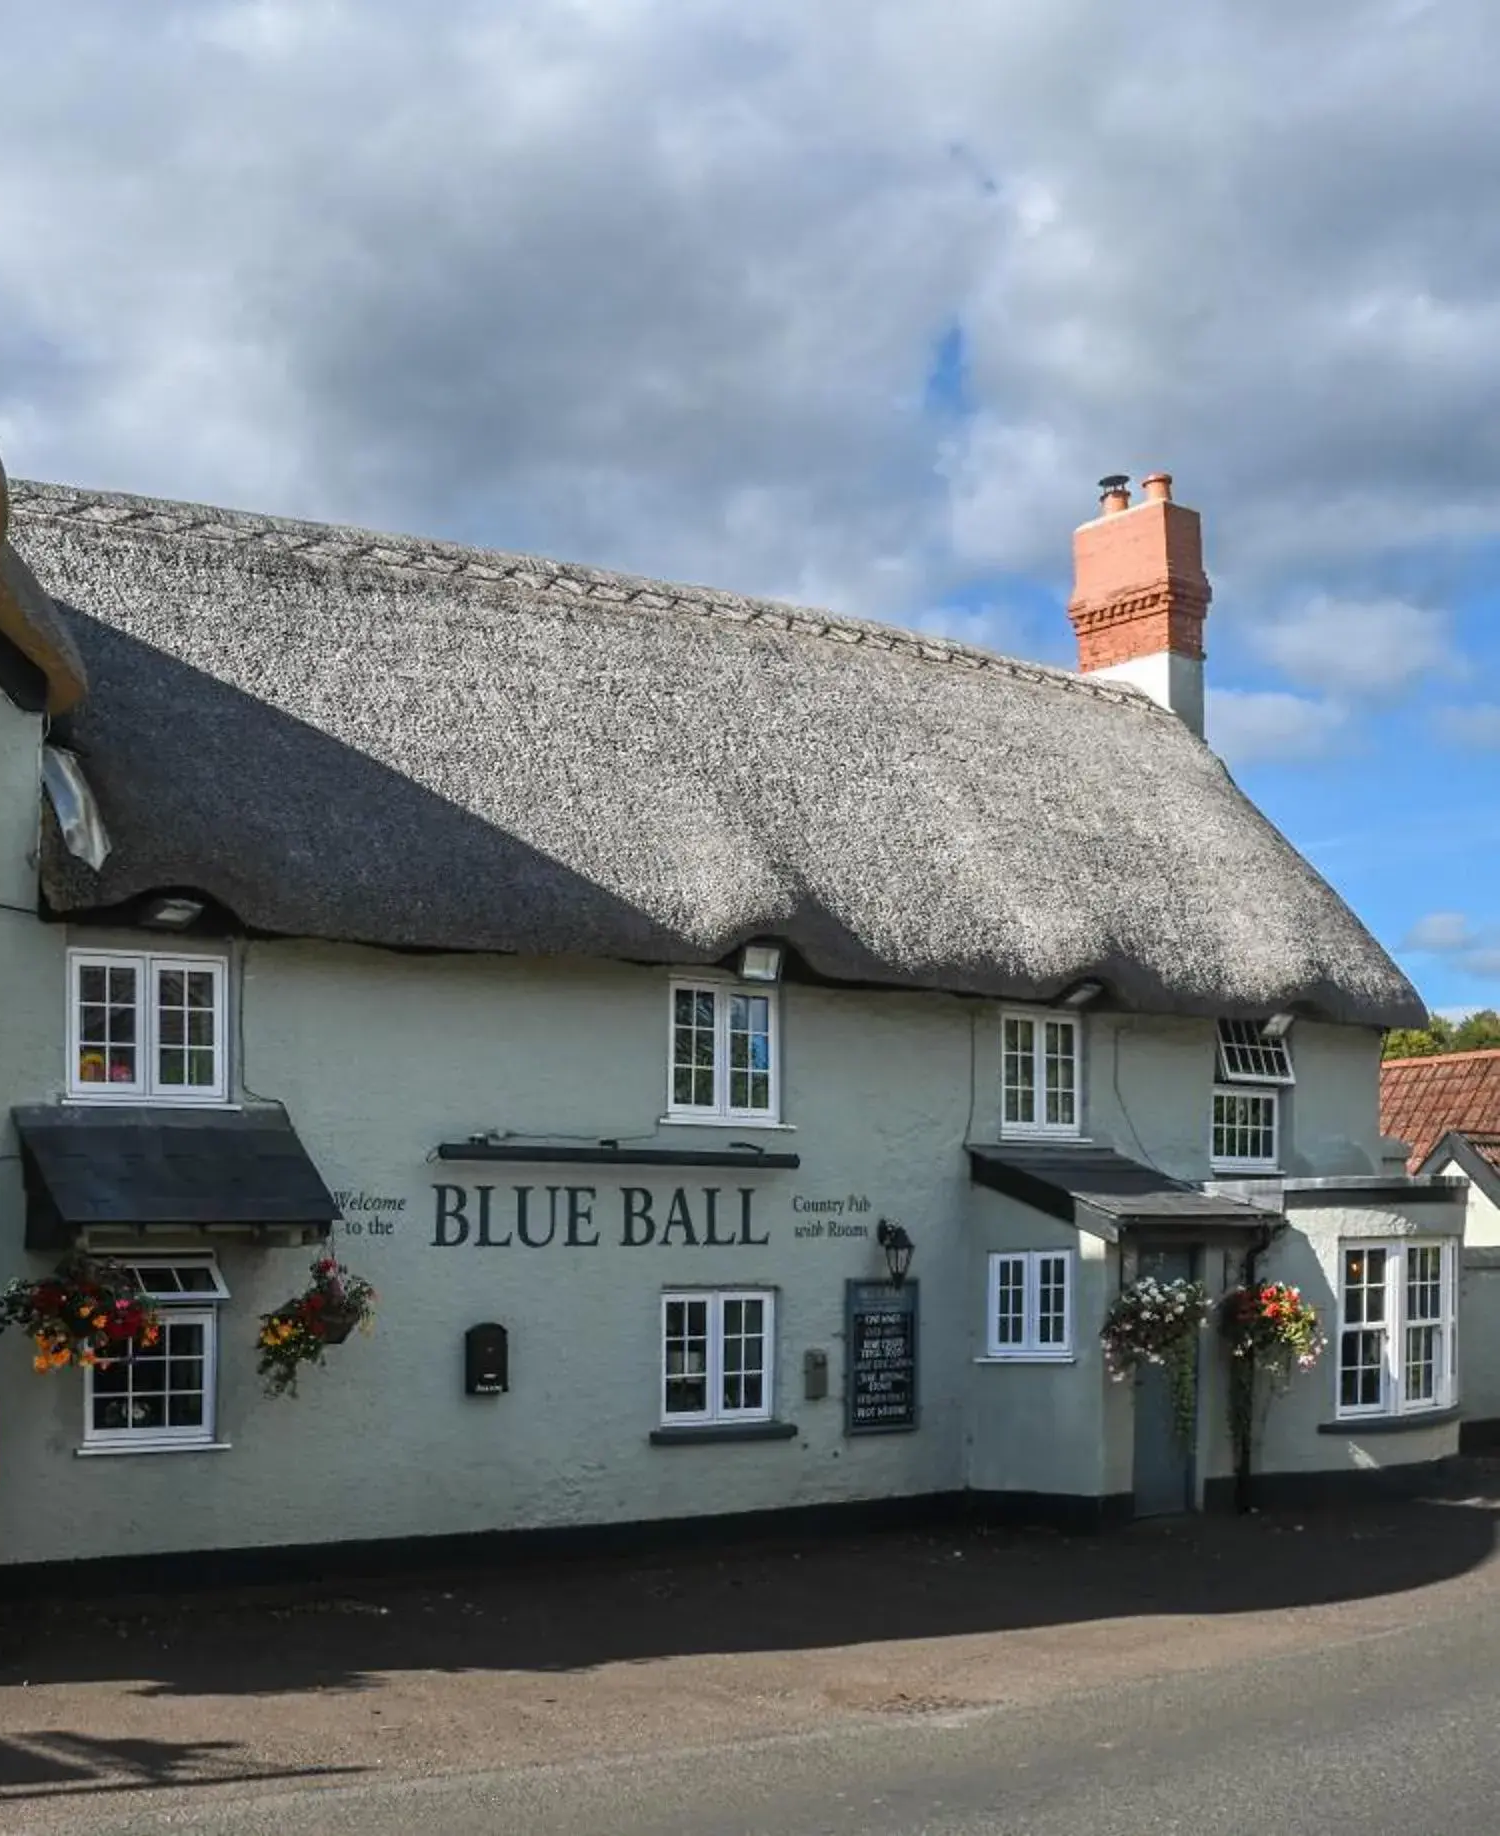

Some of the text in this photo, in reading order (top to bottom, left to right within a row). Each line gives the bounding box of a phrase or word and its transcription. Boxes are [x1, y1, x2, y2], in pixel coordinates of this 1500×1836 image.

[333, 1191, 406, 1211] Welcome
[793, 1193, 871, 1216] Country Pub
[345, 1215, 394, 1235] to the
[430, 1183, 771, 1248] BLUE BALL
[794, 1220, 868, 1238] with Rooms
